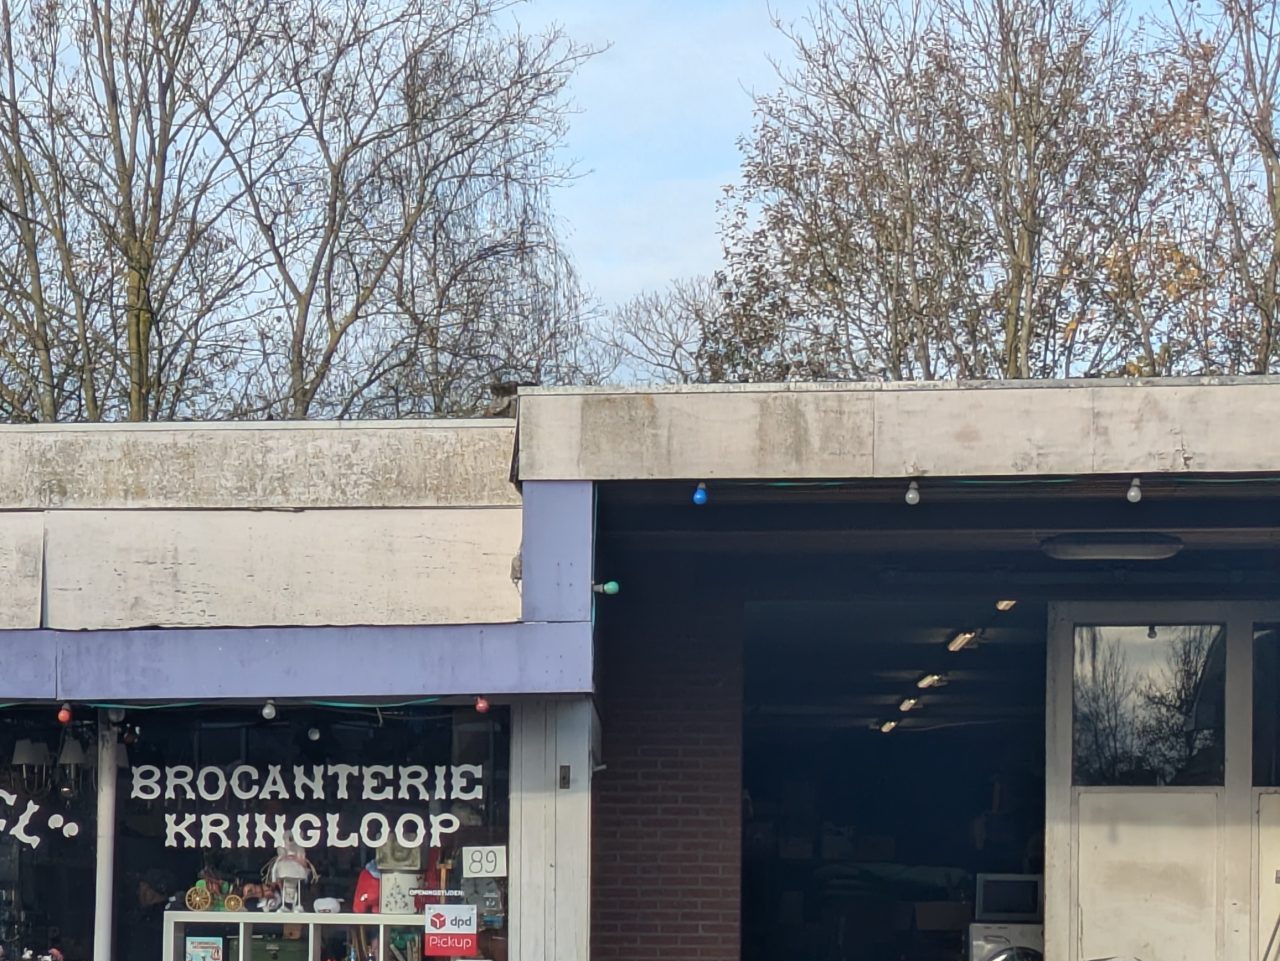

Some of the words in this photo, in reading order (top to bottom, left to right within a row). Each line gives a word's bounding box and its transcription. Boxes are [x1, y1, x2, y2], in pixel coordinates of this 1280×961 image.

[130, 763, 484, 801] BROCANTERIE
[164, 811, 461, 849] KRINGLOOP
[469, 849, 498, 874] 89
[449, 915, 472, 929] dpd
[429, 935, 472, 950] Pickup
